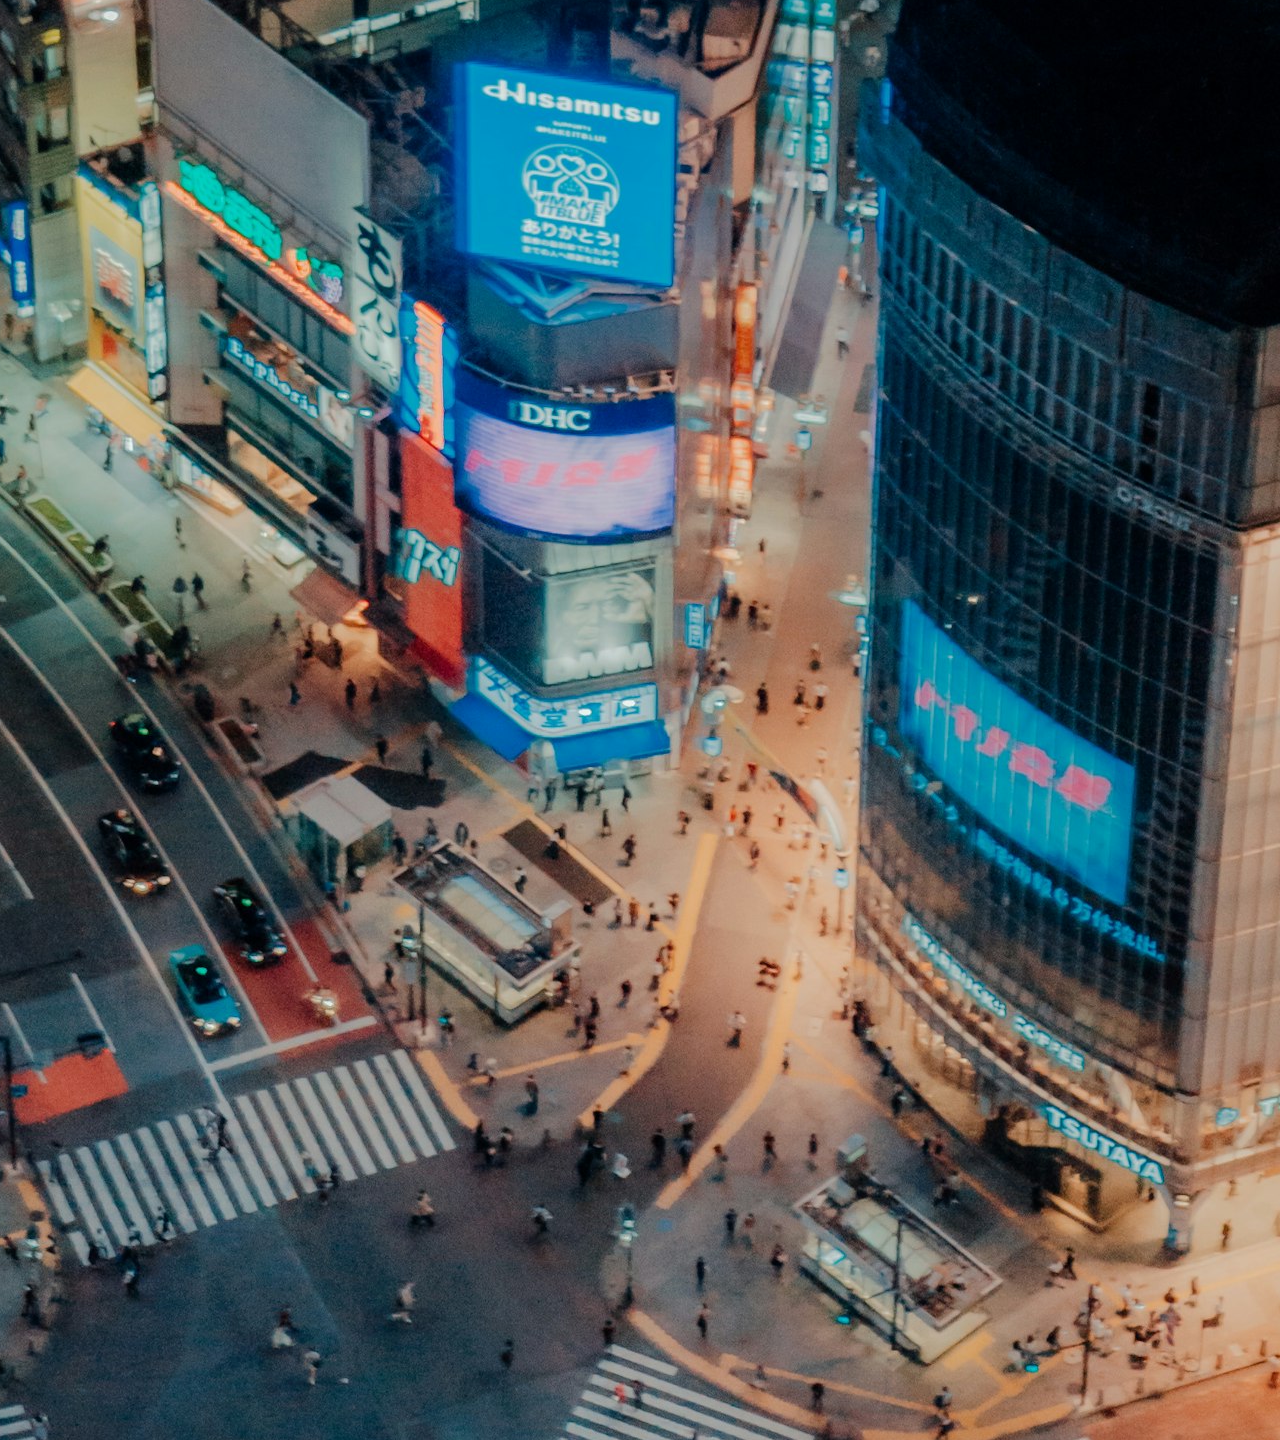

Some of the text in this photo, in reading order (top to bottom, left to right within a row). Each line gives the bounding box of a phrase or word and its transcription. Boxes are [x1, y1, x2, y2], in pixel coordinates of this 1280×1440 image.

[481, 78, 661, 127] Hisamitsu
[518, 401, 592, 432] DHC
[1042, 1103, 1165, 1185] TSUTAYA
